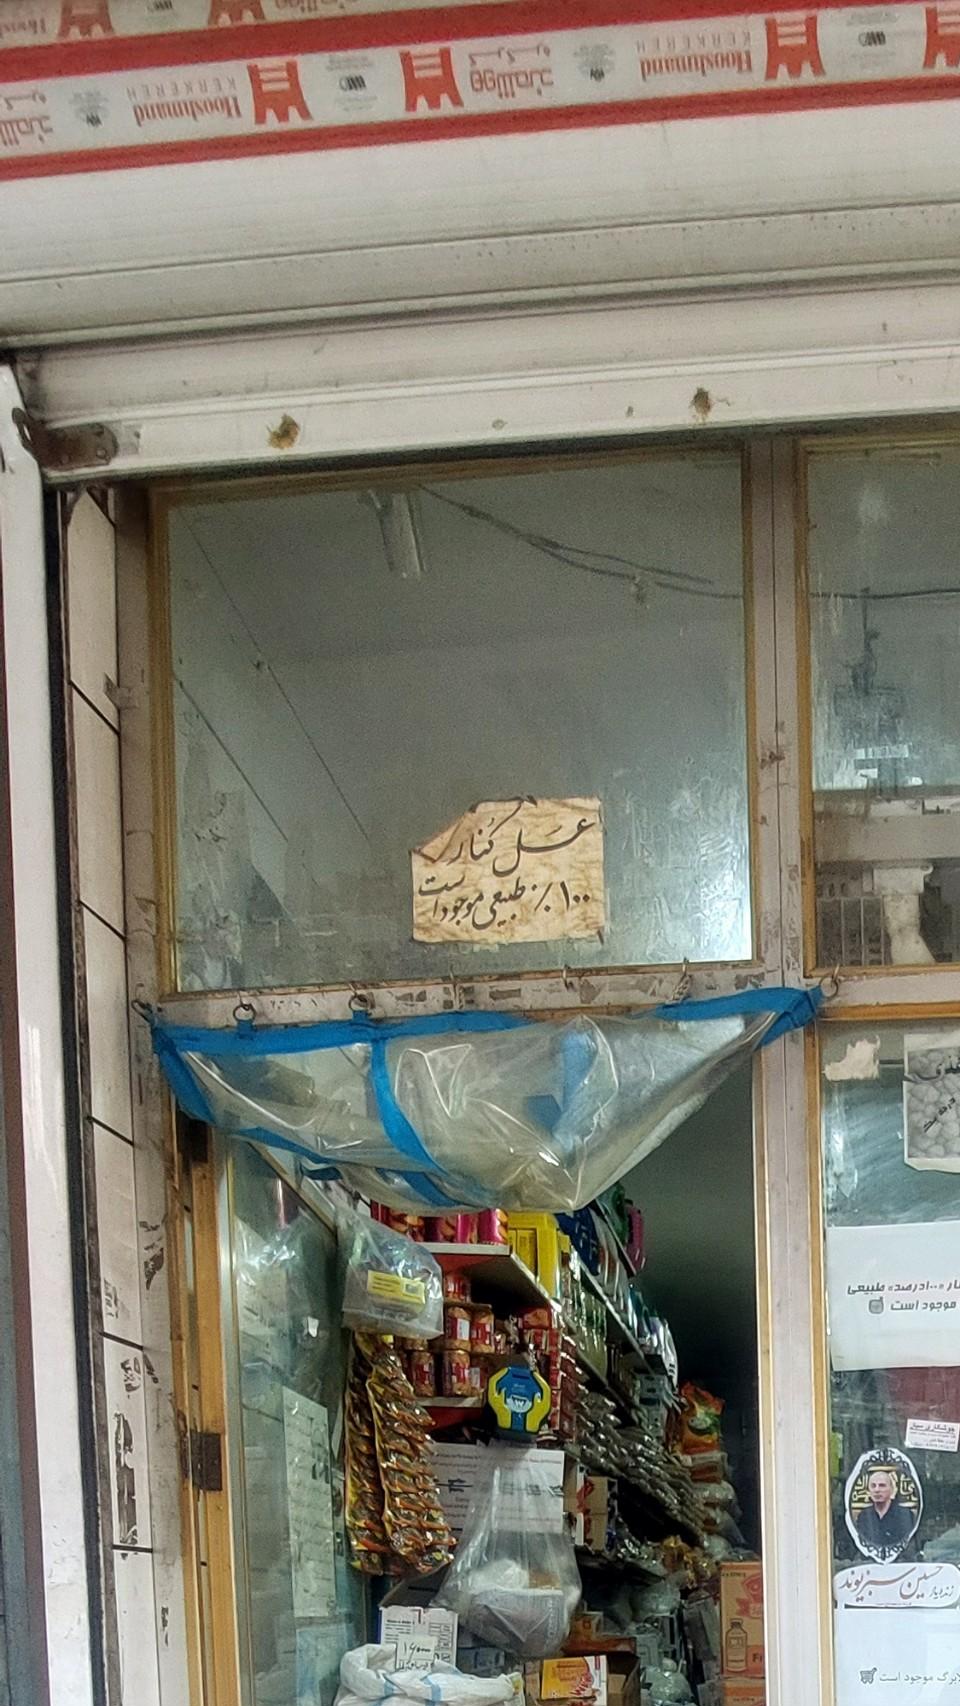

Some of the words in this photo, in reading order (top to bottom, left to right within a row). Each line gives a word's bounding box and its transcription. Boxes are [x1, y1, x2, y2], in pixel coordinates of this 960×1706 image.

[638, 50, 753, 82] Hooshmand
[469, 67, 554, 99] هوشمند
[132, 95, 242, 127] Hooshmand
[492, 817, 596, 878] عسل
[471, 876, 526, 931] طبیعی
[847, 1281, 886, 1296] طبیعی
[890, 1299, 920, 1312] است
[921, 1300, 957, 1313] موجود
[899, 1565, 944, 1600] حسین
[879, 1671, 900, 1682] است
[903, 1673, 934, 1685] موجود
